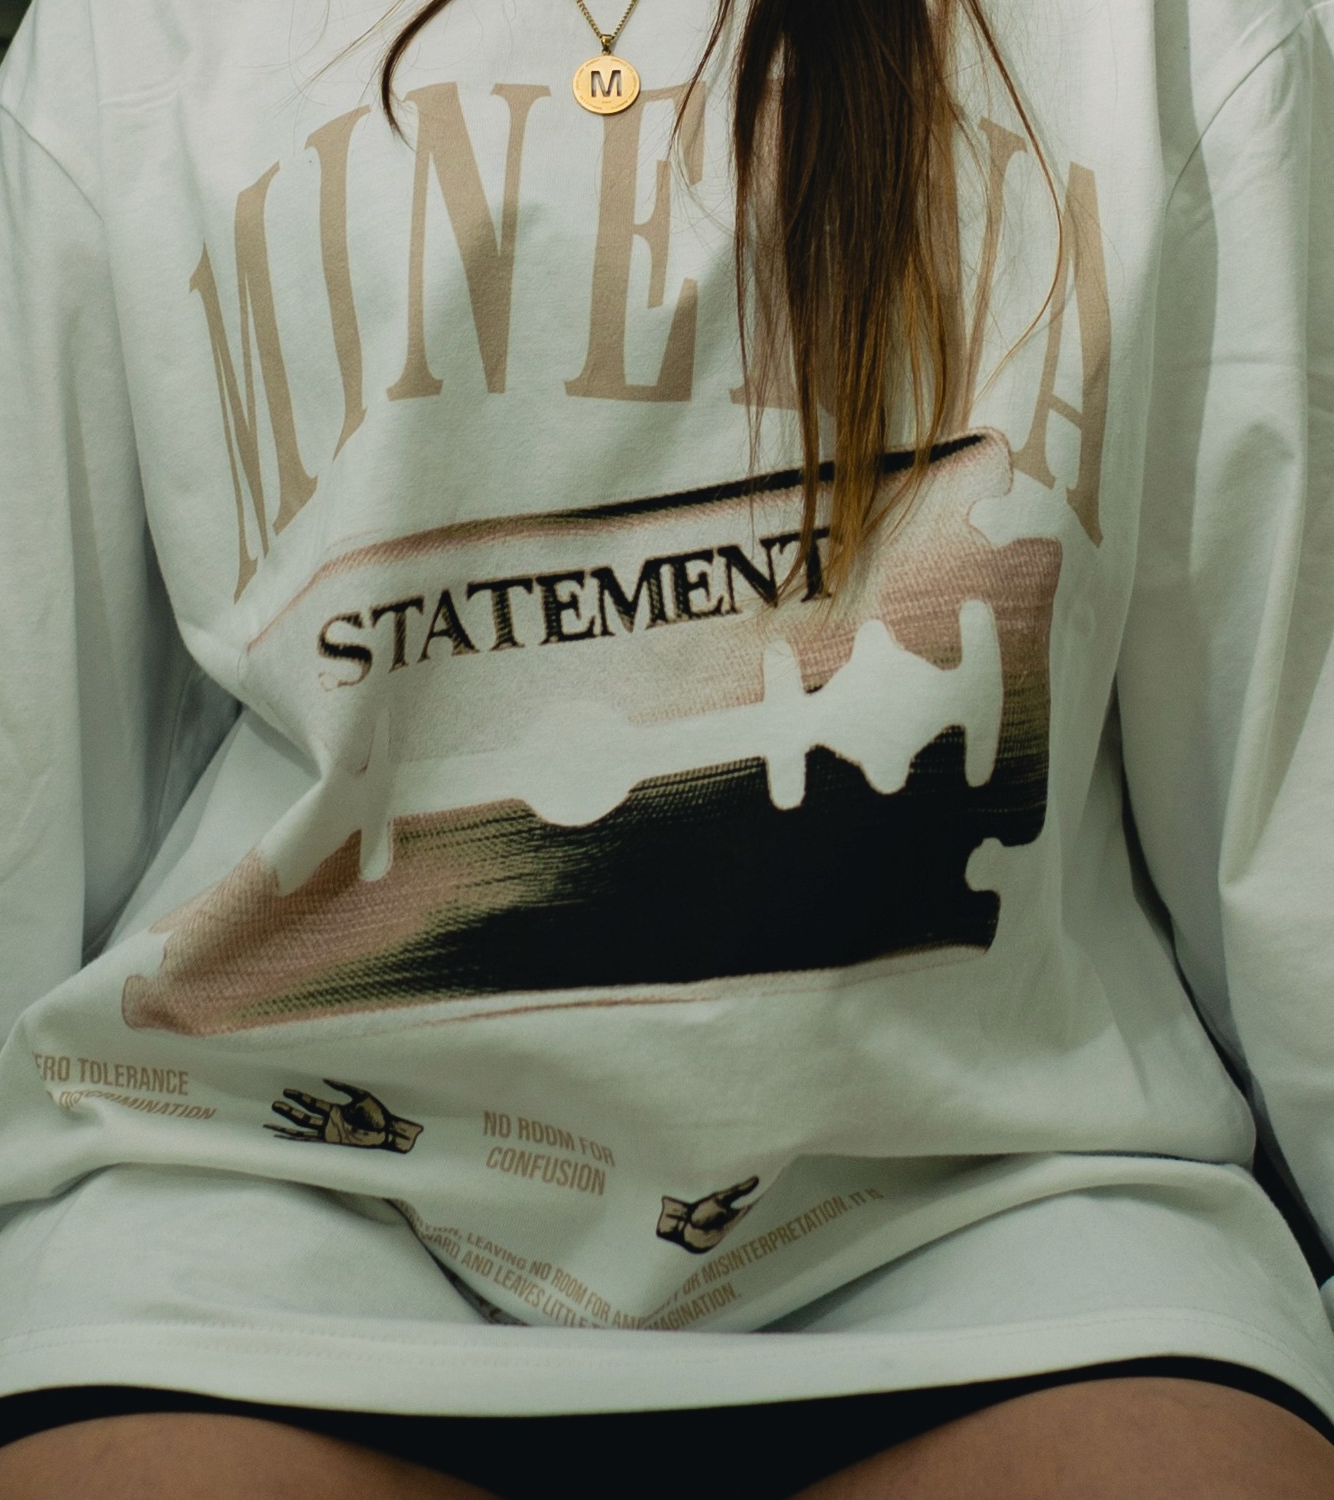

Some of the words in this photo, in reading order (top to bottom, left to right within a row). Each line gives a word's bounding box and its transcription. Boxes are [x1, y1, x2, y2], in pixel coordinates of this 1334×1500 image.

[590, 69, 622, 98] M
[317, 526, 835, 692] STATEMENT
[77, 1057, 190, 1097] TOLERANCE
[483, 1110, 512, 1139] NO
[518, 1115, 576, 1152] ROOM
[580, 1135, 616, 1168] FOR
[486, 1146, 607, 1197] CONFUSION
[701, 1195, 854, 1284] MISINTERPRETATION.
[461, 1249, 494, 1278] AND
[493, 1263, 546, 1308] LEAVES
[467, 1231, 527, 1271] LEAVING
[528, 1259, 553, 1281] NO
[551, 1267, 589, 1305] ROOM
[584, 1290, 612, 1323] FOR
